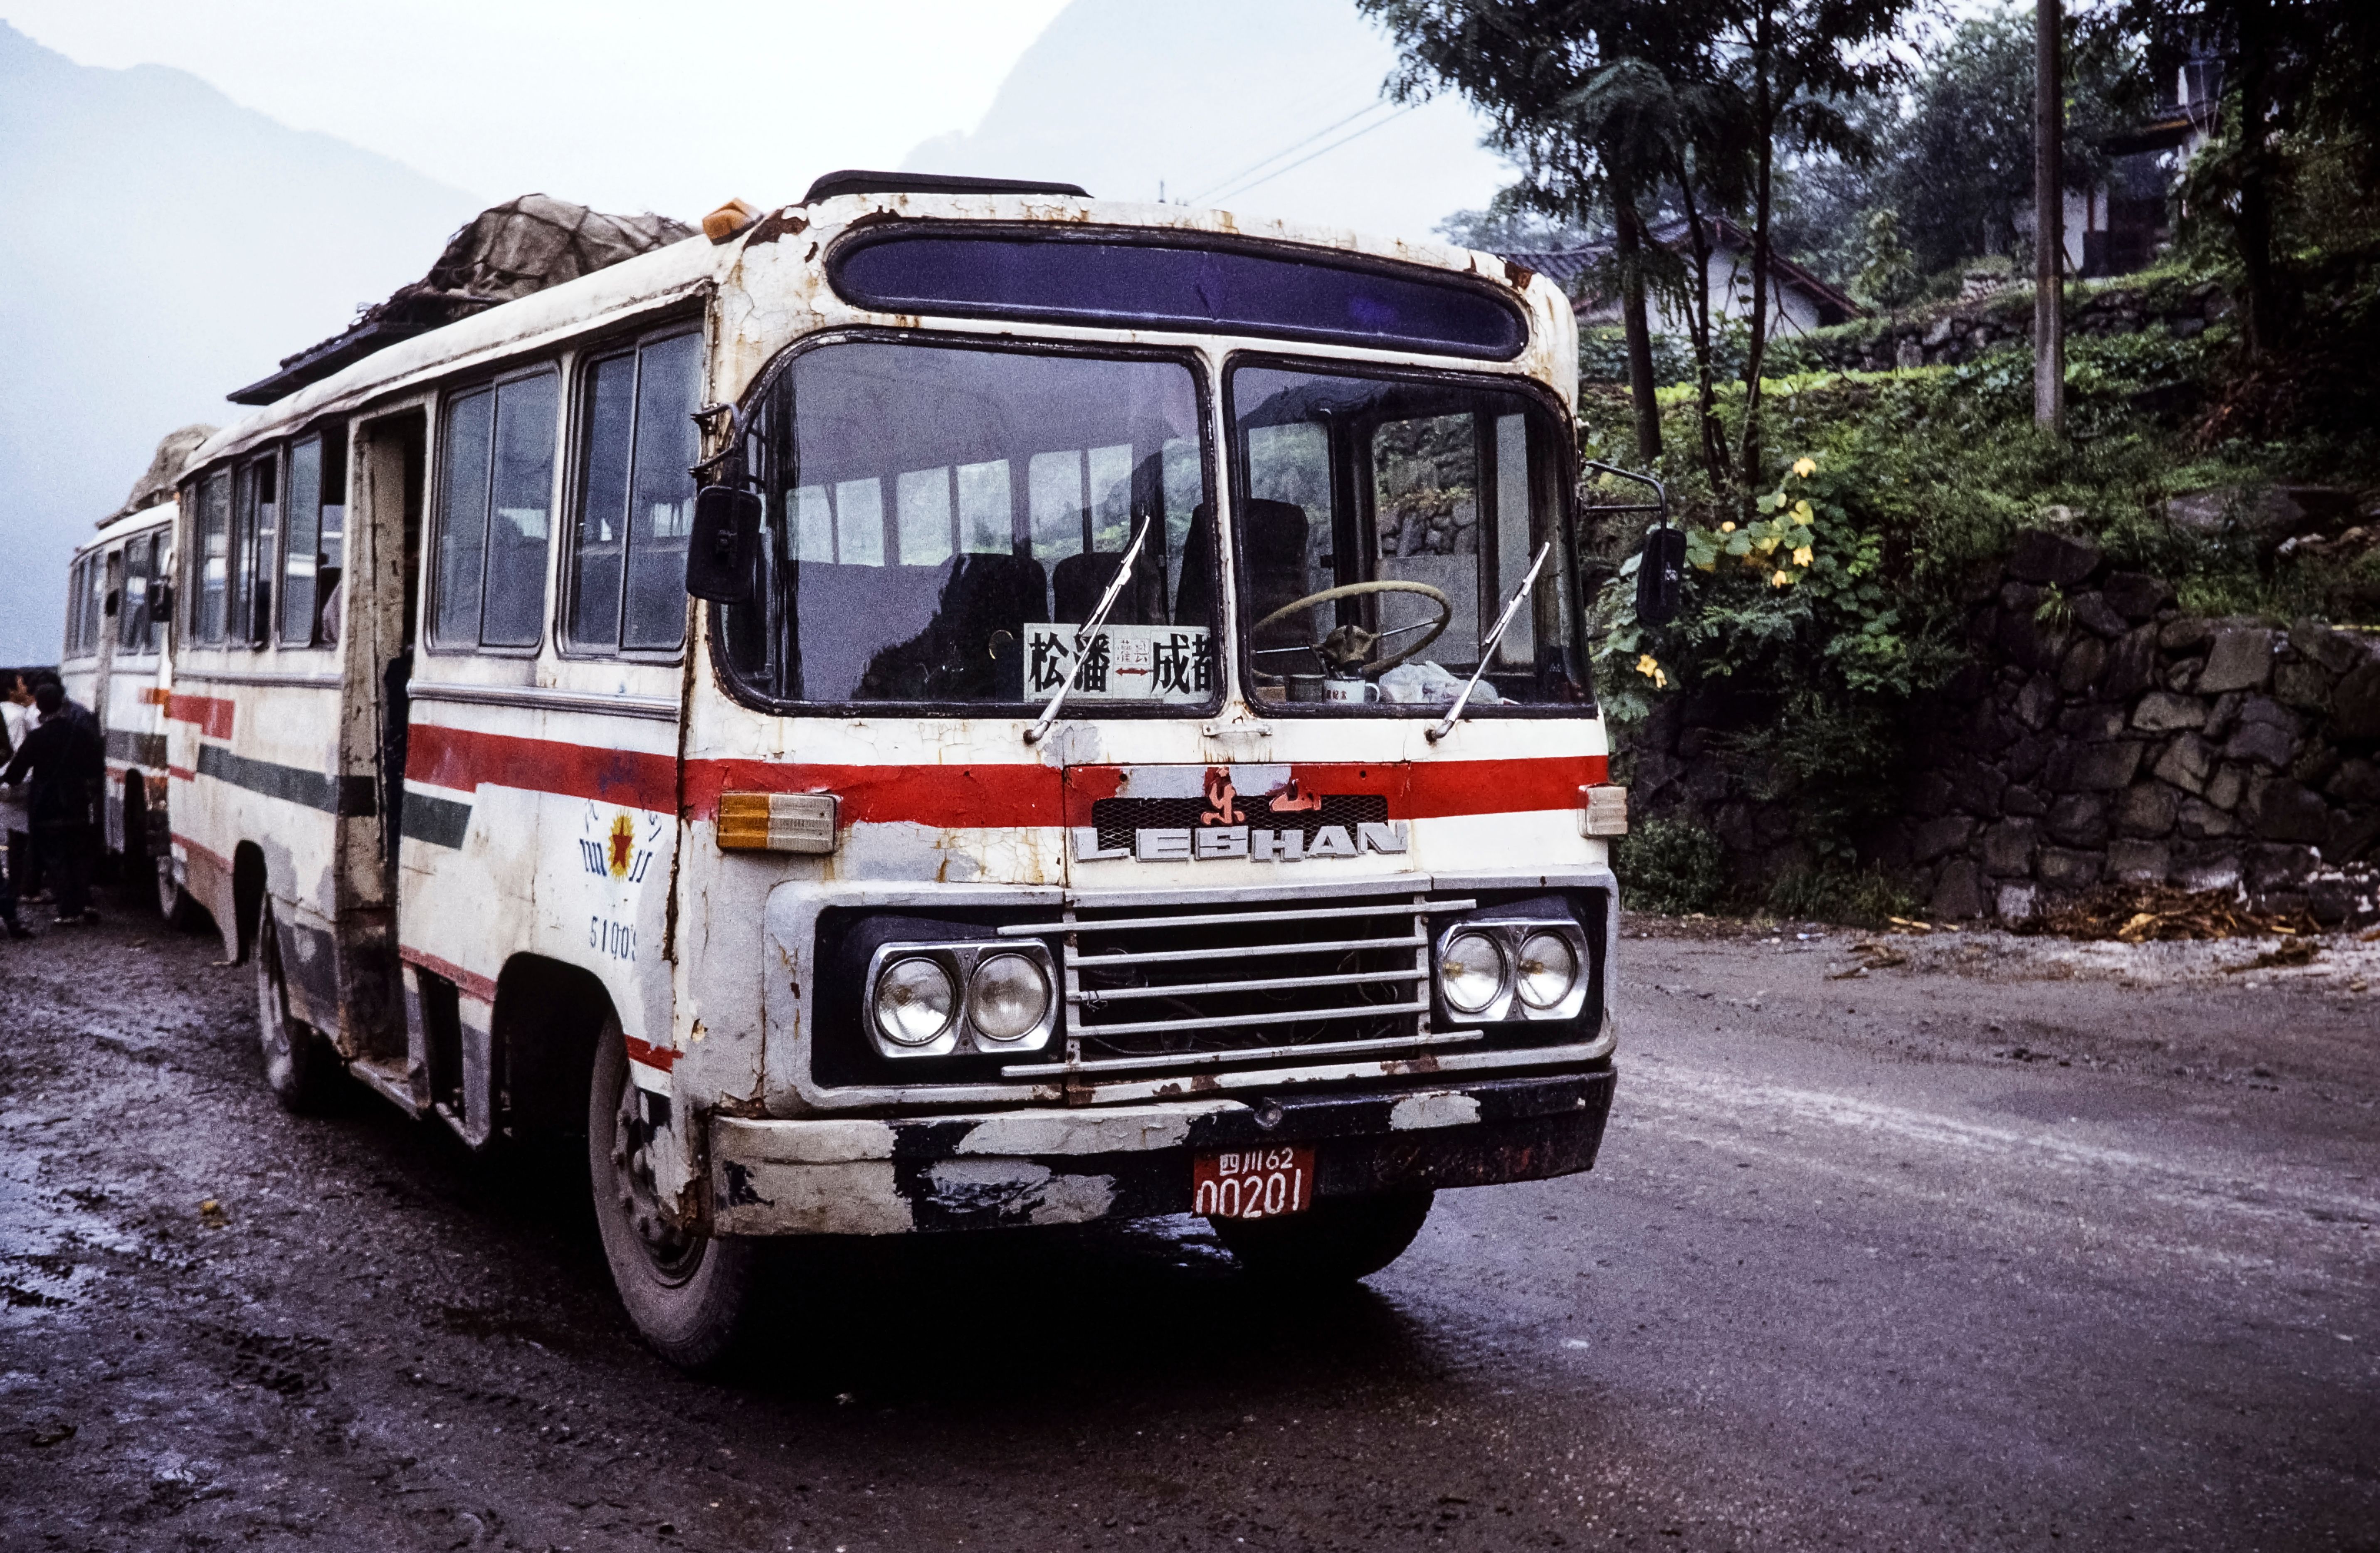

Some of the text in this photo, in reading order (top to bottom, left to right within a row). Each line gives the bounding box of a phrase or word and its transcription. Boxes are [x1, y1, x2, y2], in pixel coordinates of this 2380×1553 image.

[1029, 631, 1110, 693] 松潘
[1073, 821, 1408, 863] LESHAN
[1195, 1168, 1301, 1219] 00201
